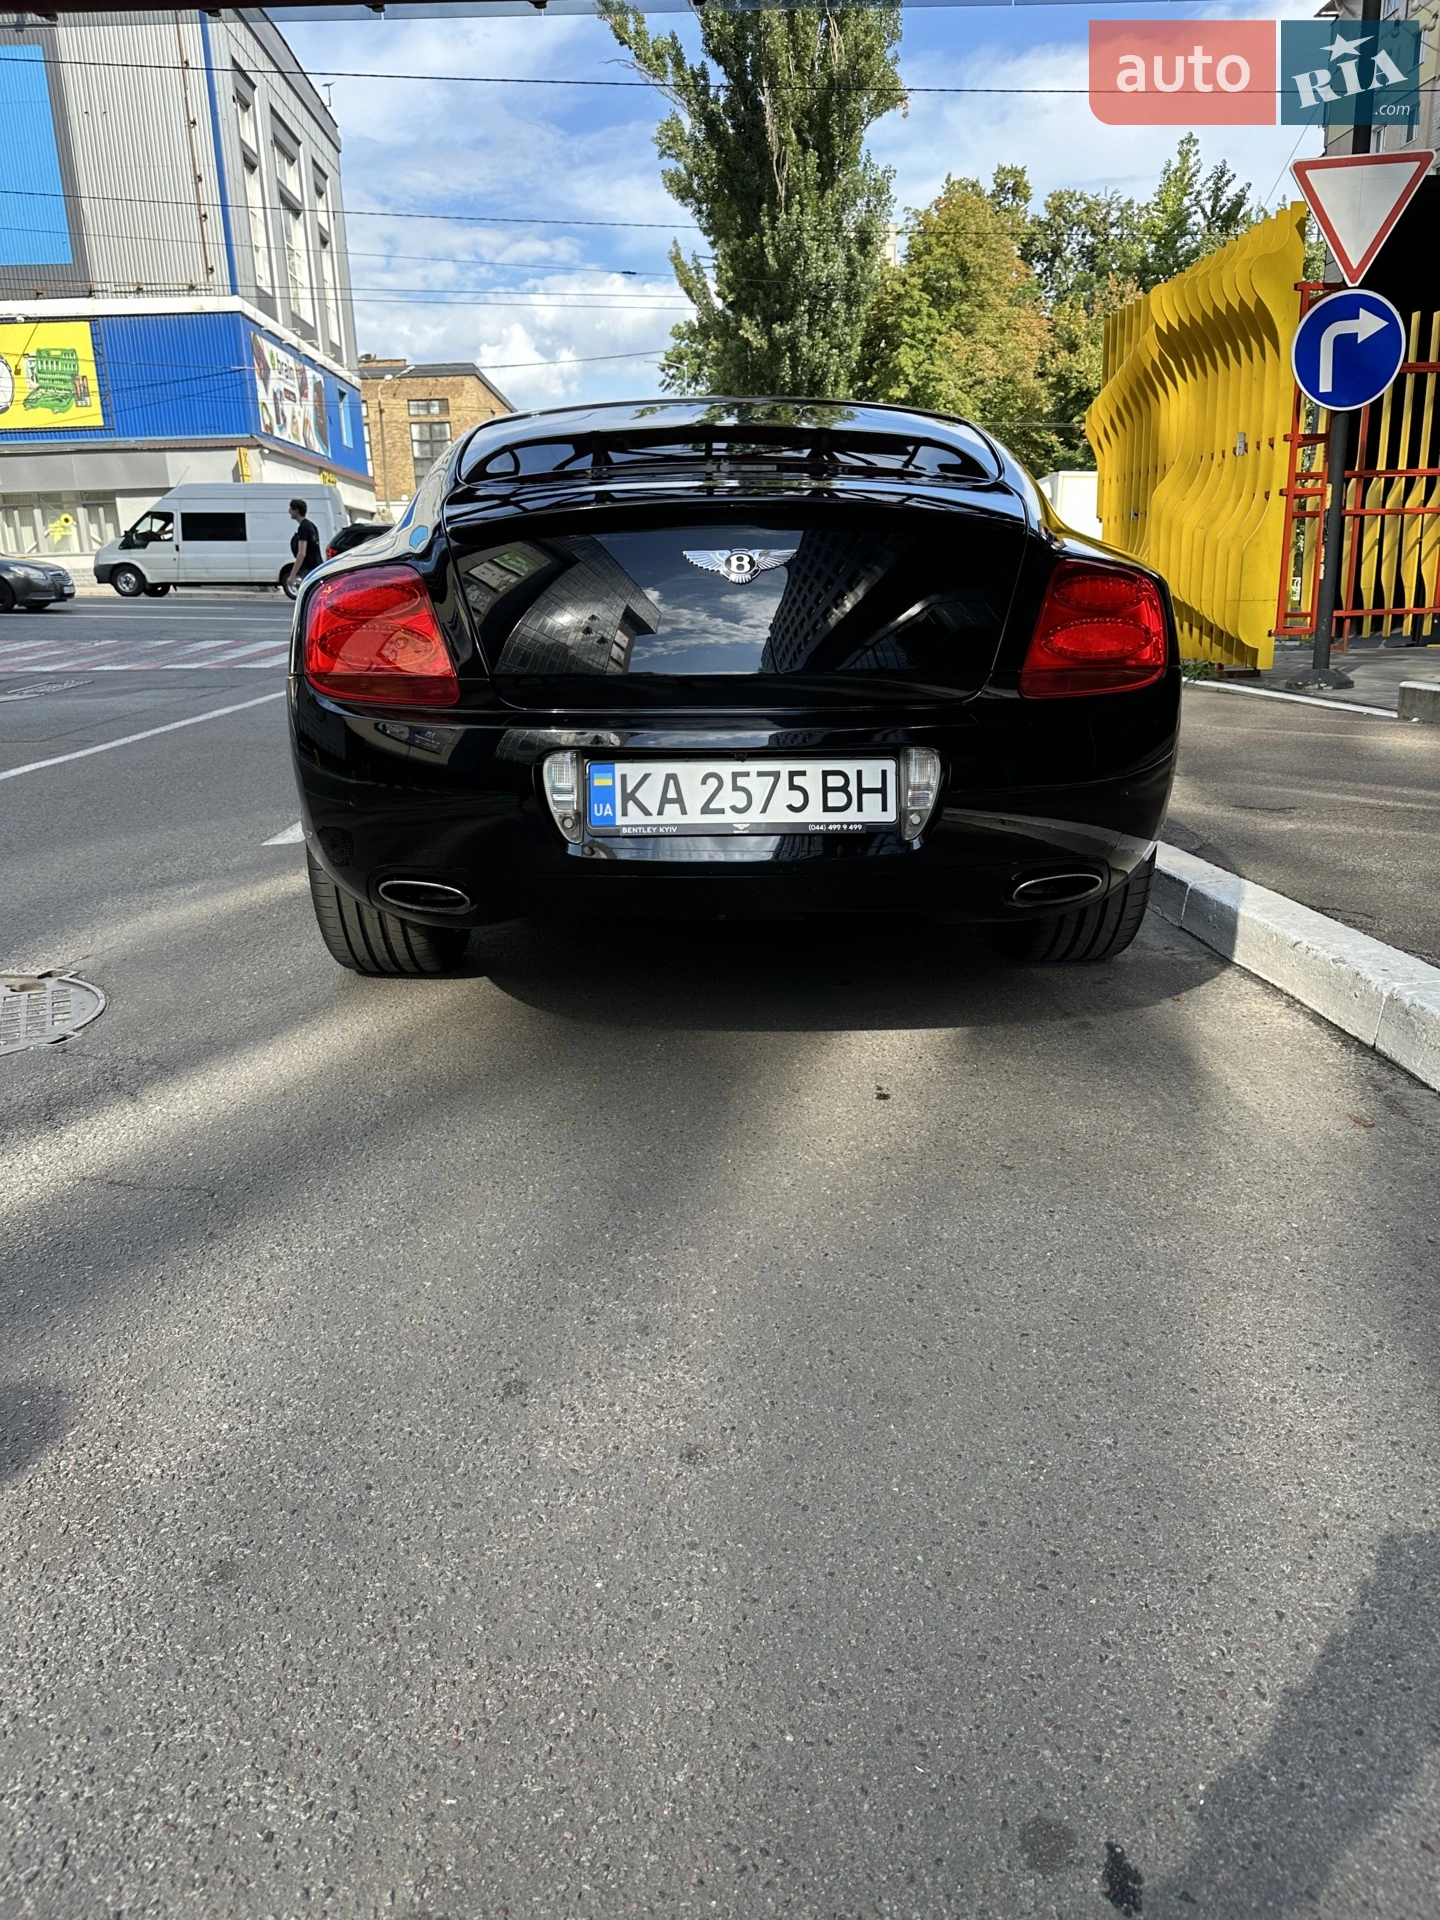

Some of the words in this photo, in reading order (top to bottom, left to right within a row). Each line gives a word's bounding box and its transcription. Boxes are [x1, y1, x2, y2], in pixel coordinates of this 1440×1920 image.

[620, 772, 688, 817] KA
[700, 770, 810, 815] 2575
[821, 769, 888, 813] BH
[593, 803, 614, 817] UA
[621, 826, 657, 834] BENTLEY
[808, 824, 827, 832] (044)
